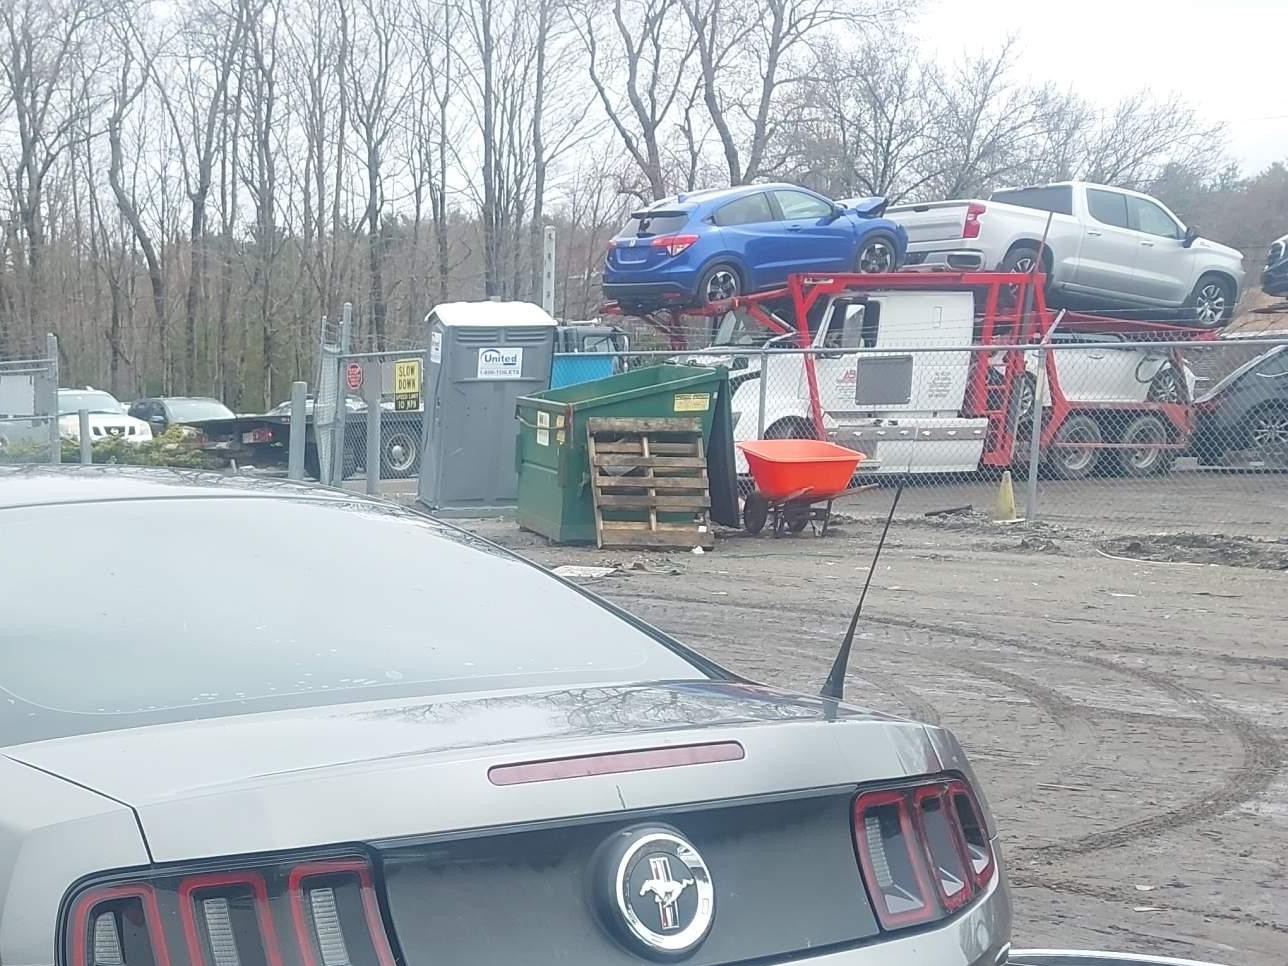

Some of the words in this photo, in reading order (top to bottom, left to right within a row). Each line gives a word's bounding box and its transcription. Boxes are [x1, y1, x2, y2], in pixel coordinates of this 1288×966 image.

[484, 353, 517, 363] United
[398, 365, 415, 377] SLOW
[398, 379, 416, 390] DOWN
